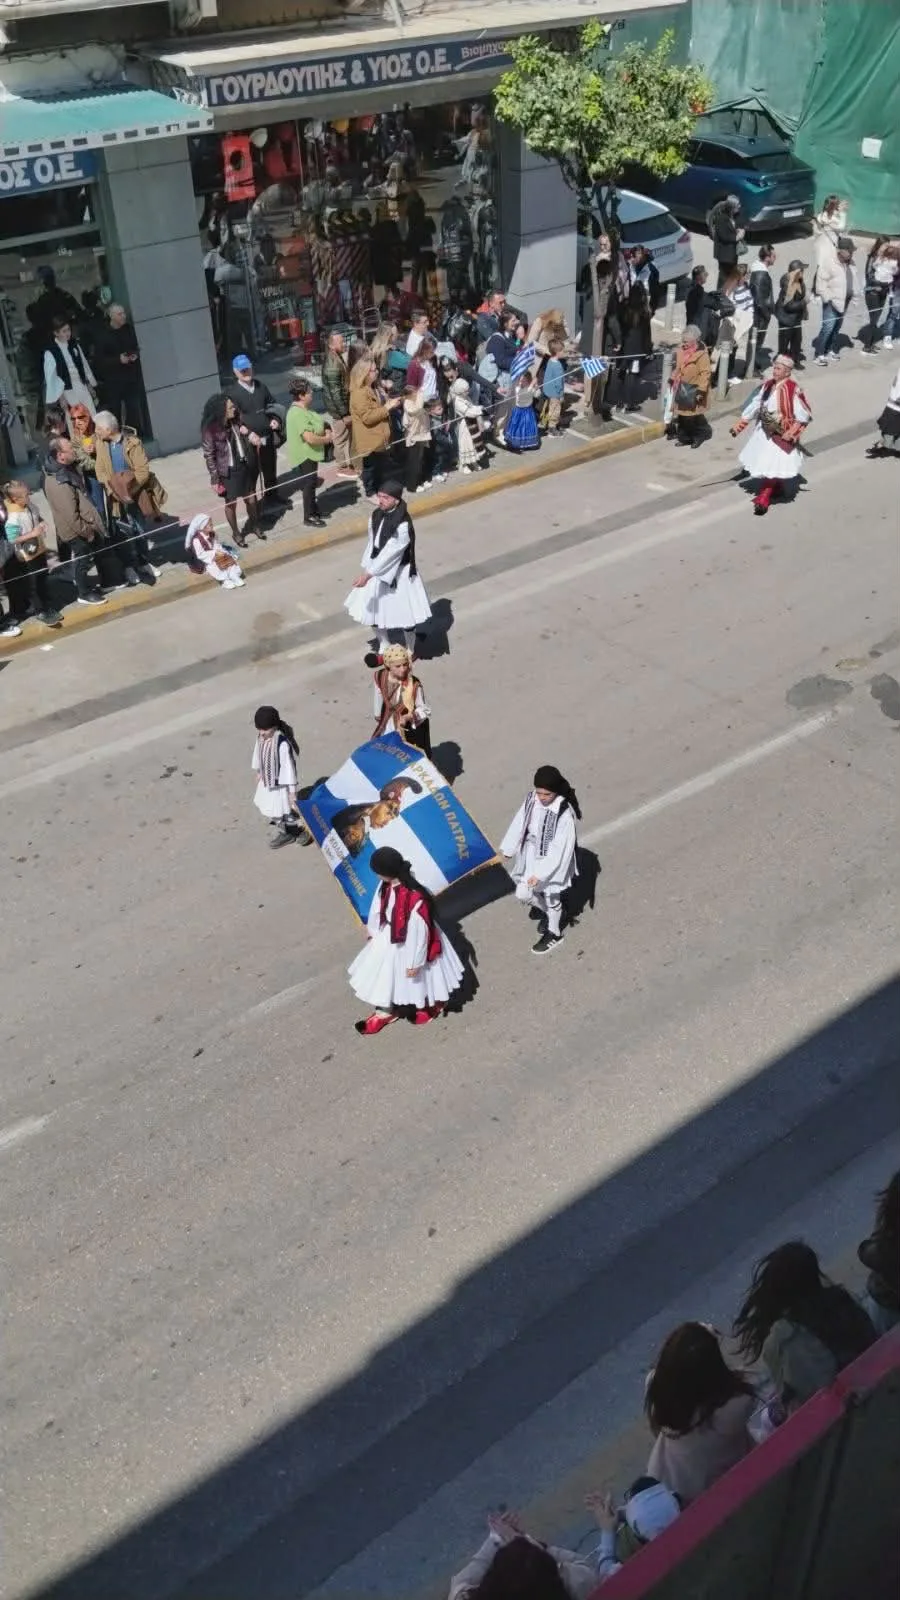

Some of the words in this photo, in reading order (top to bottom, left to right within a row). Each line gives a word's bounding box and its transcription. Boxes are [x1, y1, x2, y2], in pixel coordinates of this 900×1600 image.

[461, 40, 507, 59] Βιομηχα
[209, 62, 347, 105] ΓΟΥΡΔΟΥΠΗΣ
[350, 59, 366, 85] &
[367, 53, 412, 81] ΥΙΟΣ
[415, 48, 452, 75] Ο.Ε.
